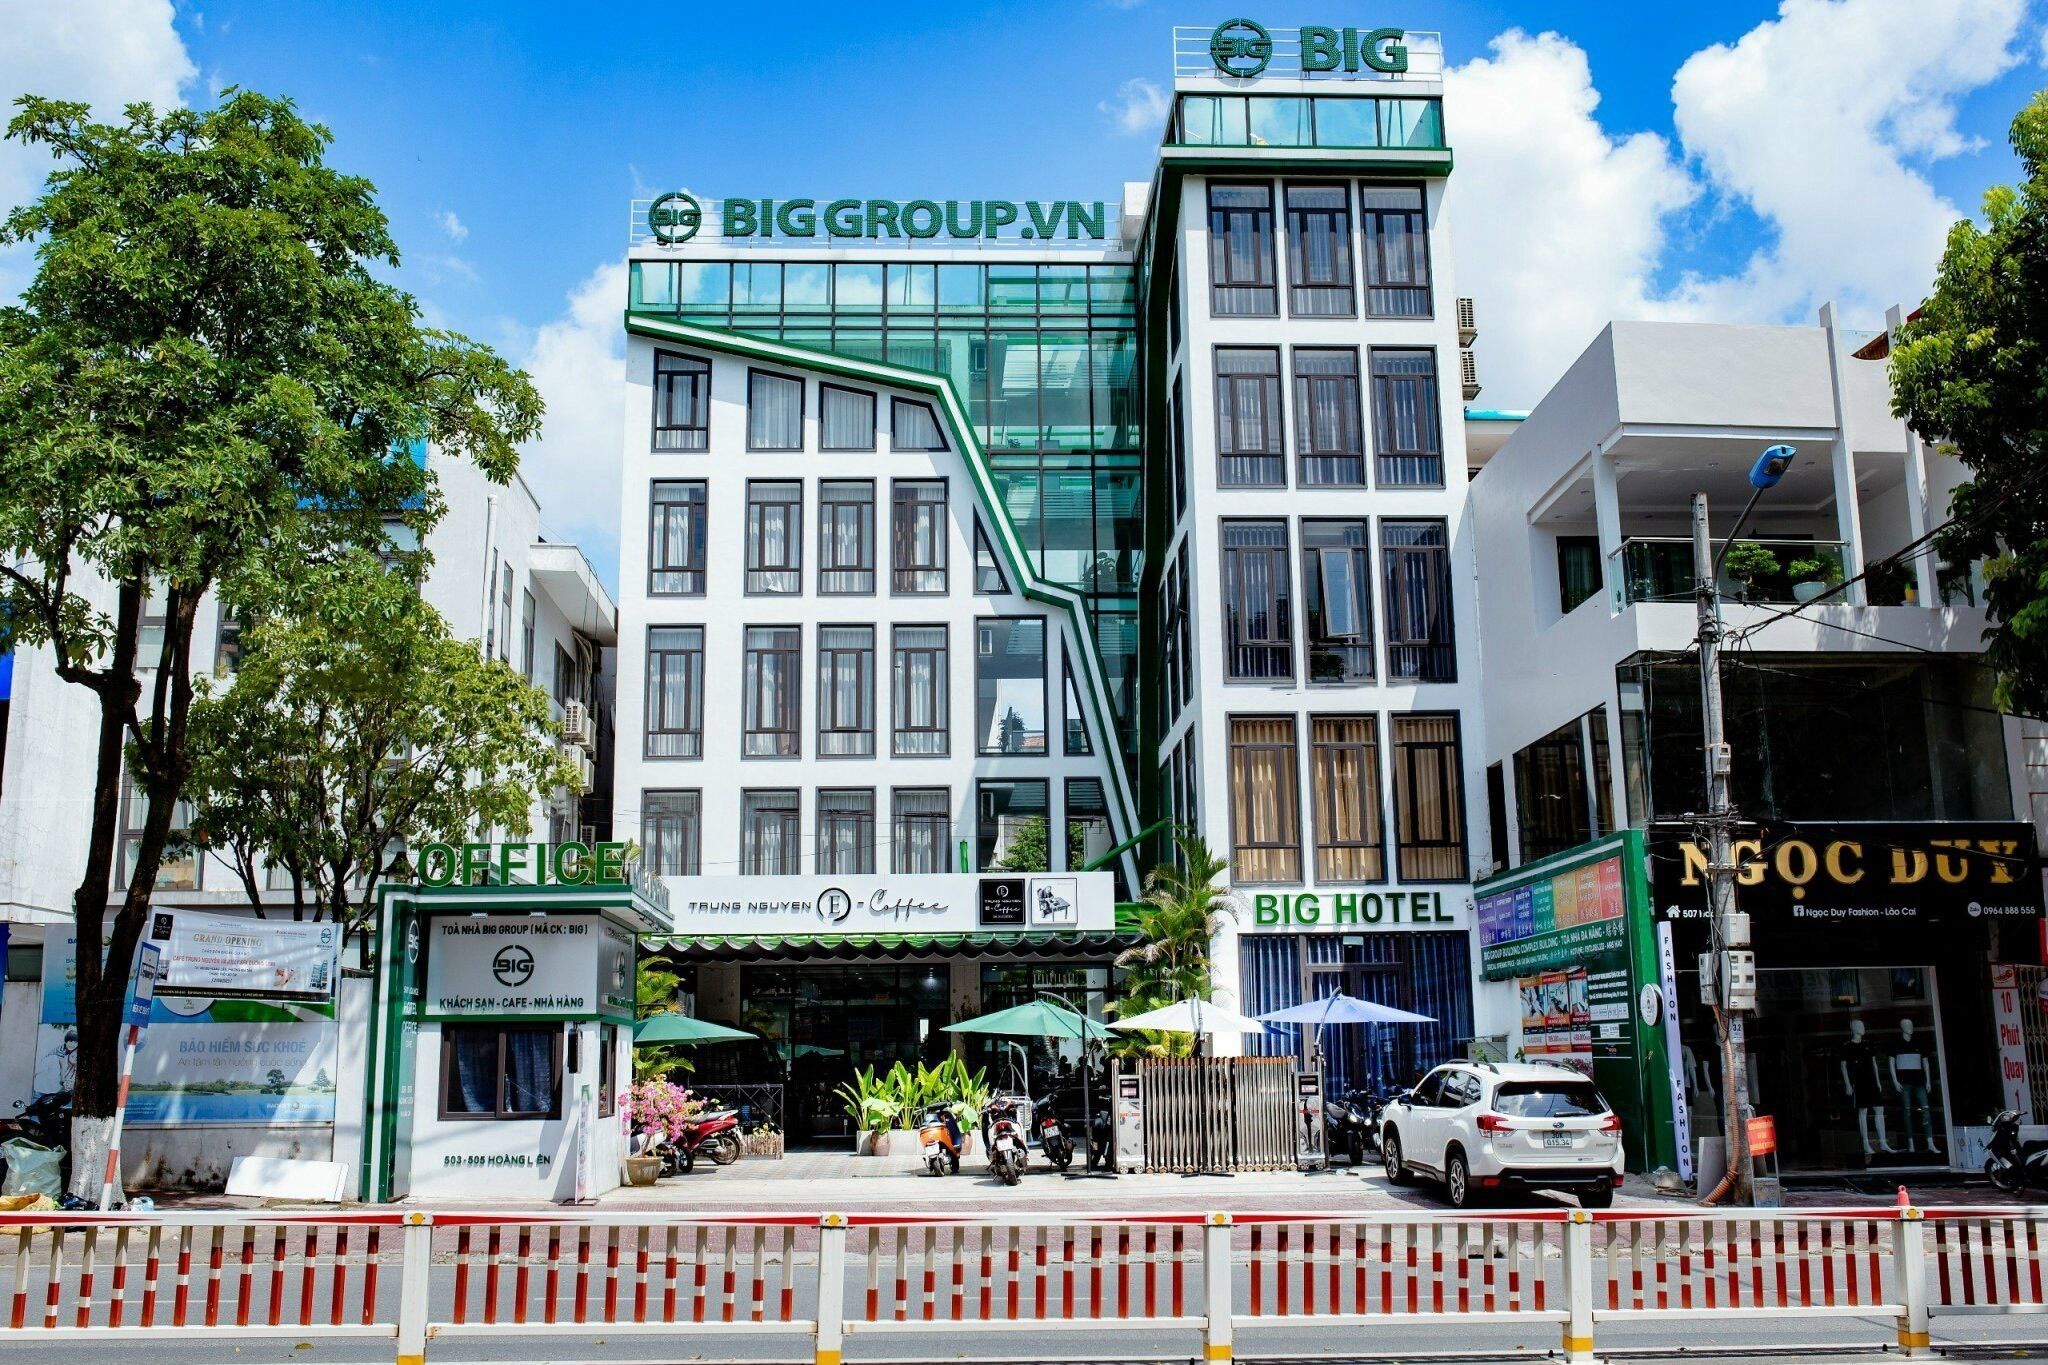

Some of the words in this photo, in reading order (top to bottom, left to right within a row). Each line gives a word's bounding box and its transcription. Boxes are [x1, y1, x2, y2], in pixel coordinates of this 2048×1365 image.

[1301, 26, 1408, 72] BIG
[418, 841, 626, 887] OFFICE
[1679, 839, 1866, 900] NGỌC
[1890, 839, 2017, 884] DUY
[689, 902, 741, 912] TRUNG
[870, 888, 949, 922] Coffee
[1255, 893, 1321, 925] BIG
[1334, 892, 1454, 924] HOTEL
[1683, 909, 1698, 918] 507
[1806, 908, 1829, 919] Ngọc
[1831, 908, 1847, 917] Duy
[1848, 907, 1879, 916] Fashion
[1885, 907, 1900, 916] Lào
[1902, 907, 1917, 916] Cai
[1983, 906, 2003, 915] 0964
[2005, 906, 2019, 915] 888
[2020, 906, 2036, 915] 555
[193, 933, 222, 944] GRAND
[225, 935, 263, 947] OPENING
[442, 923, 460, 935] TOÀ
[461, 922, 481, 935] NHÀ
[482, 925, 497, 935] BIG
[498, 925, 529, 935] GROUP
[1664, 936, 1677, 1022] FASHION
[440, 995, 473, 1009] KHÁCH
[474, 998, 495, 1011] SẠN
[502, 998, 527, 1008] CAFE
[534, 995, 555, 1008] NHÀ
[556, 995, 584, 1008] HÀNG
[2001, 991, 2013, 1014] 10
[179, 1037, 206, 1053] BẢO
[209, 1036, 241, 1053] HIỂM
[2000, 1023, 2021, 1046] Phút
[2003, 1056, 2025, 1083] Quay
[1676, 1079, 1690, 1166] FASHION
[488, 1154, 525, 1165] HOÀNG
